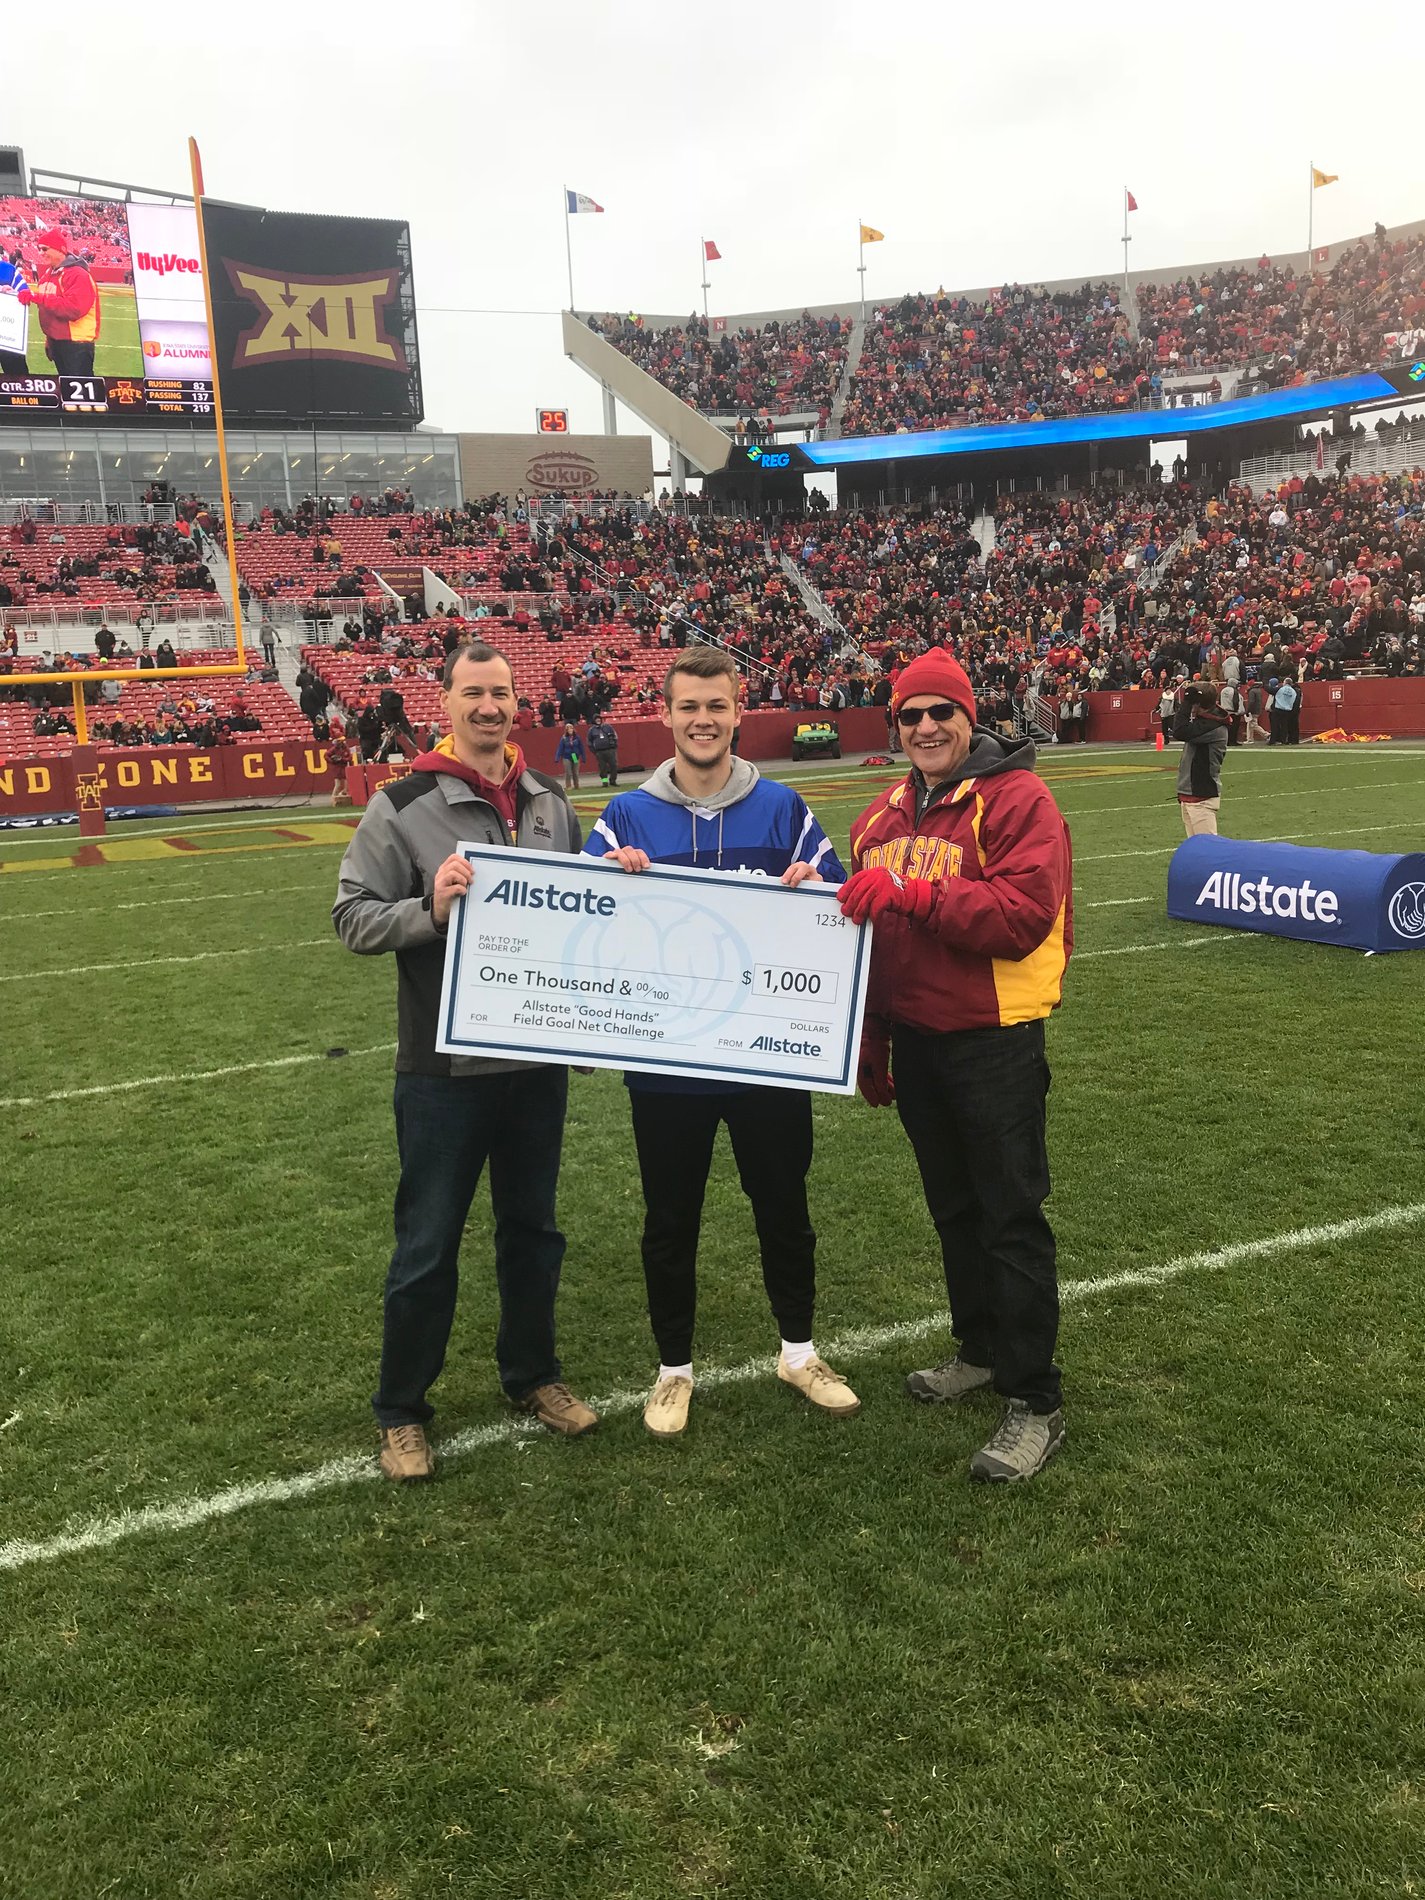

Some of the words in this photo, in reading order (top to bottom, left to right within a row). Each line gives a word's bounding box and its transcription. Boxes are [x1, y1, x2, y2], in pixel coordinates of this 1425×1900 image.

[236, 271, 397, 361] XII
[69, 381, 95, 400] 21
[193, 382, 205, 391] 82
[11, 397, 28, 405] BALL
[29, 397, 39, 405] ON
[192, 393, 209, 402] 137
[159, 404, 184, 412] TOTAL
[193, 404, 210, 413] 219
[543, 412, 565, 431] 25
[761, 453, 790, 468] REG
[532, 463, 592, 487] Sukup
[1331, 690, 1341, 700] 15
[1112, 699, 1121, 708] 16
[907, 835, 964, 883] STATE
[484, 879, 617, 917] Allstate
[1195, 871, 1339, 923] Allstate
[815, 913, 846, 928] 1234
[478, 943, 508, 953] ORDER
[510, 945, 522, 953] OF
[479, 934, 496, 943] PAY
[498, 936, 511, 945] TO
[512, 938, 529, 947] THE
[480, 966, 518, 984] One
[524, 969, 615, 994] Thousand
[619, 980, 632, 996] &
[741, 970, 752, 985] $
[763, 969, 821, 994] 1,000
[522, 999, 571, 1014] Allstate
[470, 1013, 488, 1022] FOR
[513, 1013, 543, 1026] Field
[546, 1016, 575, 1030] Goal
[578, 1019, 601, 1032] Net
[603, 1022, 665, 1041] Challenge
[790, 1022, 830, 1034] DOLLARS
[718, 1038, 743, 1048] FROM
[749, 1035, 821, 1057] Allstate
